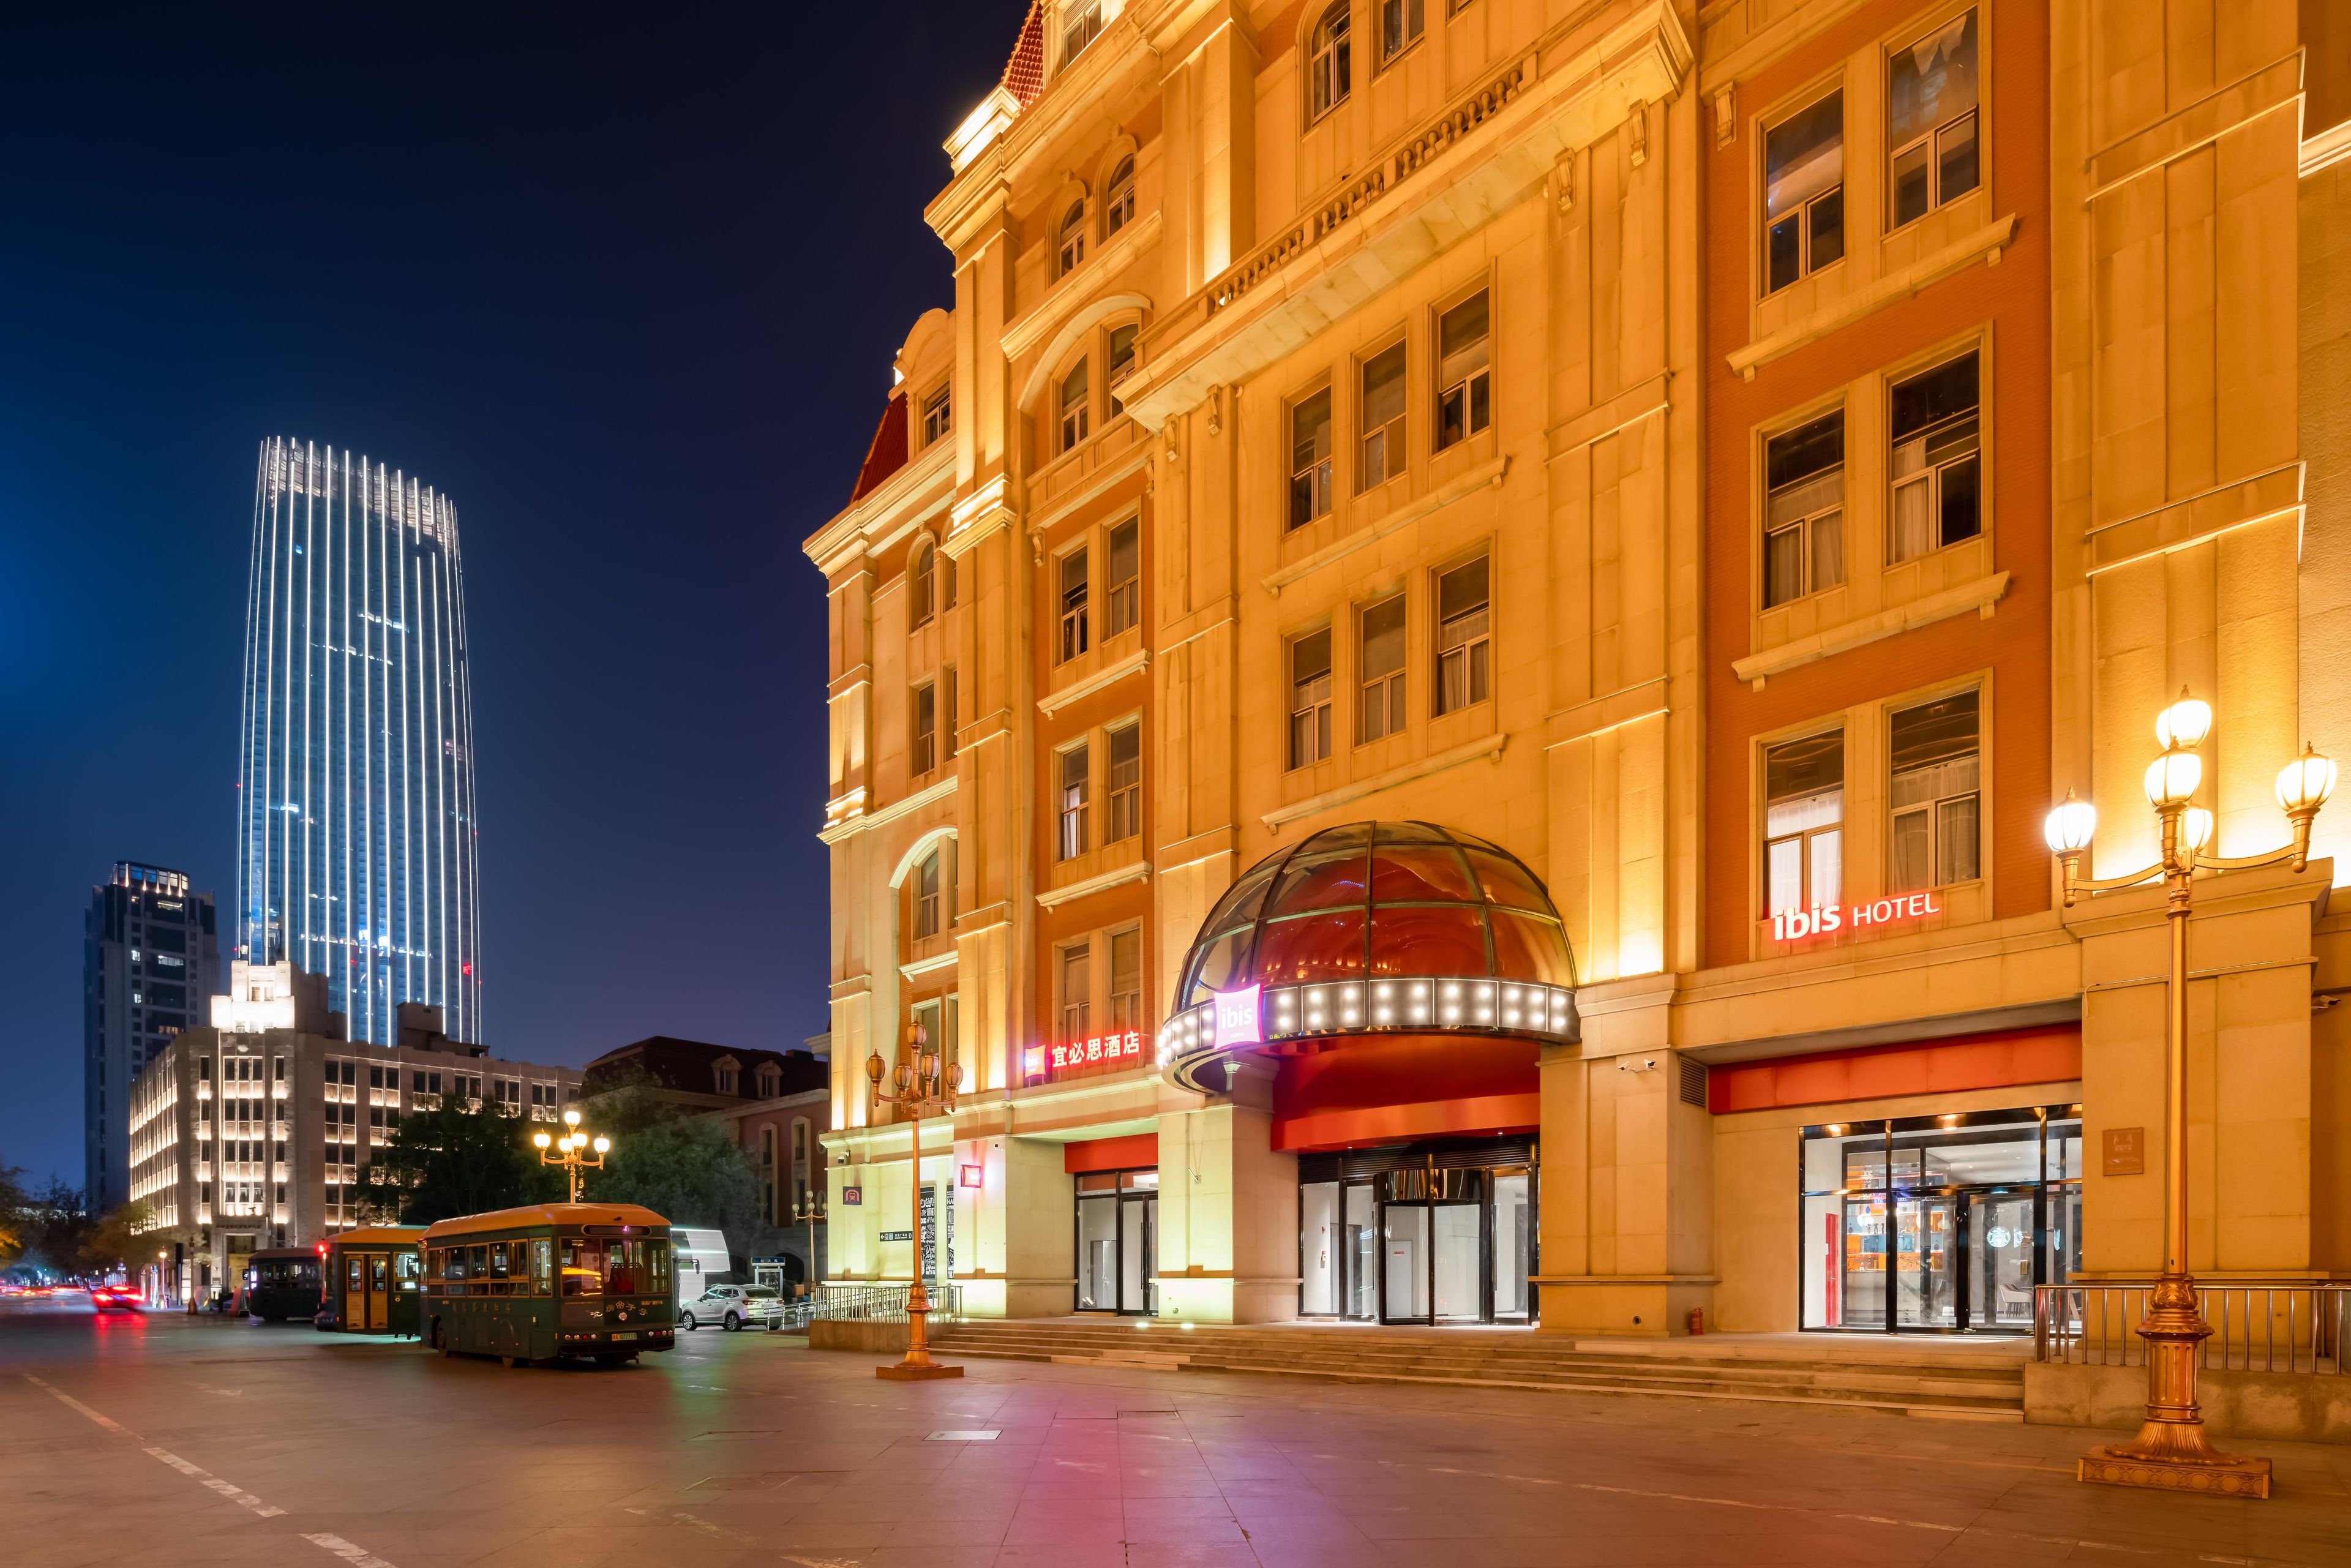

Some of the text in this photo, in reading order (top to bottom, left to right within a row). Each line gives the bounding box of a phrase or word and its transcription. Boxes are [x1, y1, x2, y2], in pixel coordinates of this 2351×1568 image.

[1774, 893, 1940, 940] ibis HOTEL
[1221, 1004, 1253, 1029] ibis
[1052, 1030, 1139, 1067] 宜必思酒店
